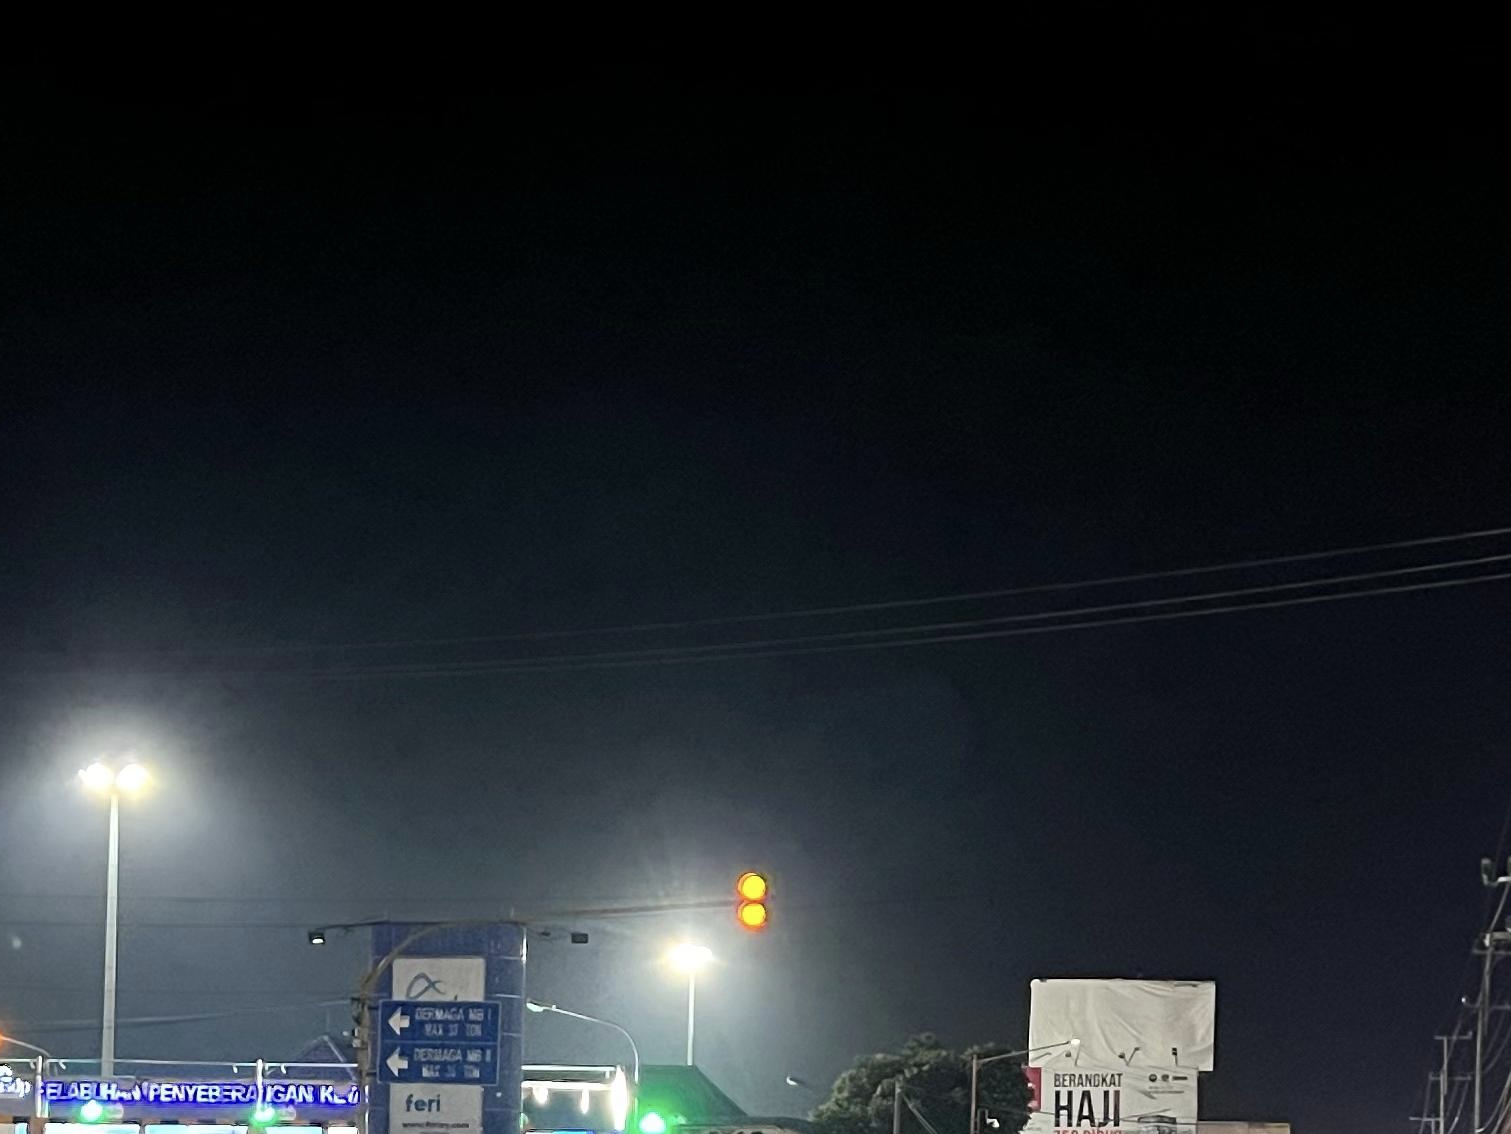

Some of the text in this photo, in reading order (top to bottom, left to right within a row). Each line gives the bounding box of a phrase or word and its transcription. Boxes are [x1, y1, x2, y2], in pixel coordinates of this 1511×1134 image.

[1054, 1073, 1123, 1088] BERANGKAT
[405, 1094, 441, 1112] feri
[1054, 1090, 1121, 1128] HAJI
